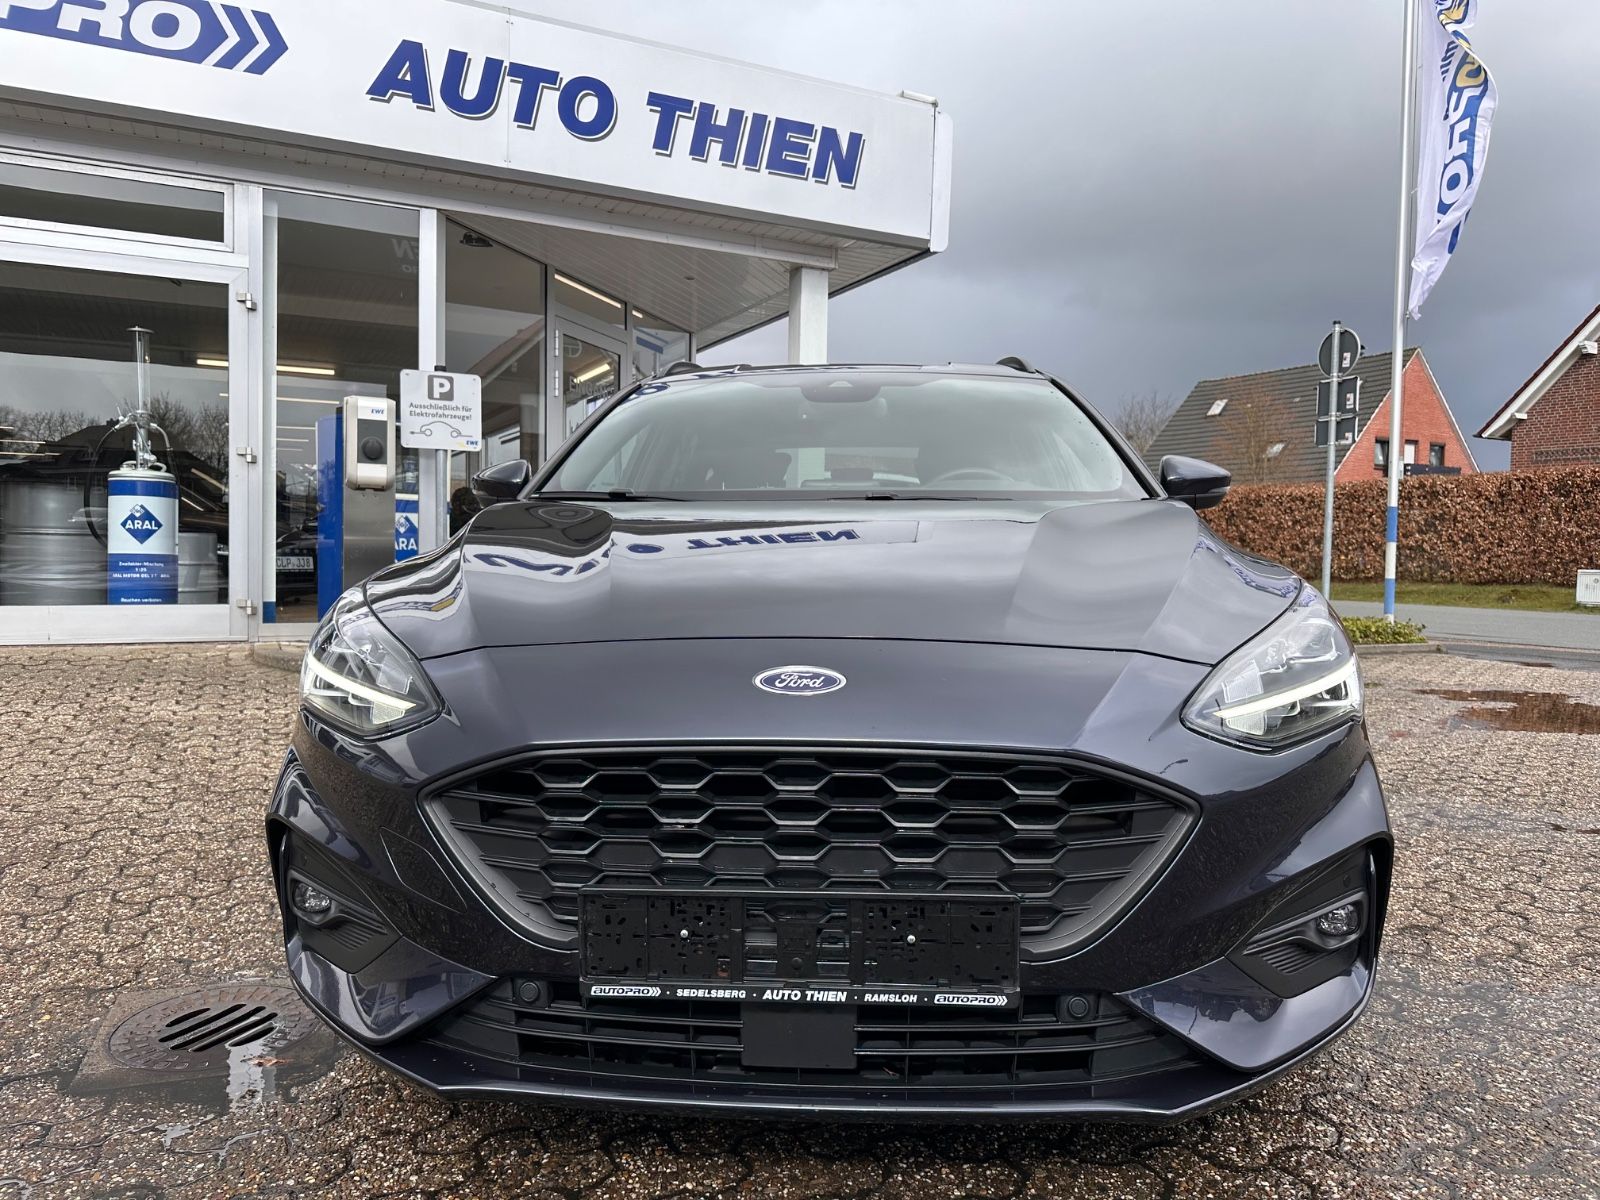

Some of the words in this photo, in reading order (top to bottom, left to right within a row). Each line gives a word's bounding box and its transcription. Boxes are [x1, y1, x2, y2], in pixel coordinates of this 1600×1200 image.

[366, 39, 617, 142] AUTO
[646, 91, 865, 189] THIEN
[433, 377, 451, 399] P
[409, 402, 461, 412] Ausschließlich
[409, 410, 473, 422] Elektrofahrzeuge!
[125, 519, 159, 530] ARAL
[774, 671, 826, 689] Ford
[676, 988, 747, 999] SEDELSBERG
[762, 989, 802, 1001] AUTO
[804, 990, 848, 1002] THIEN
[863, 993, 918, 1003] RAMSLOH
